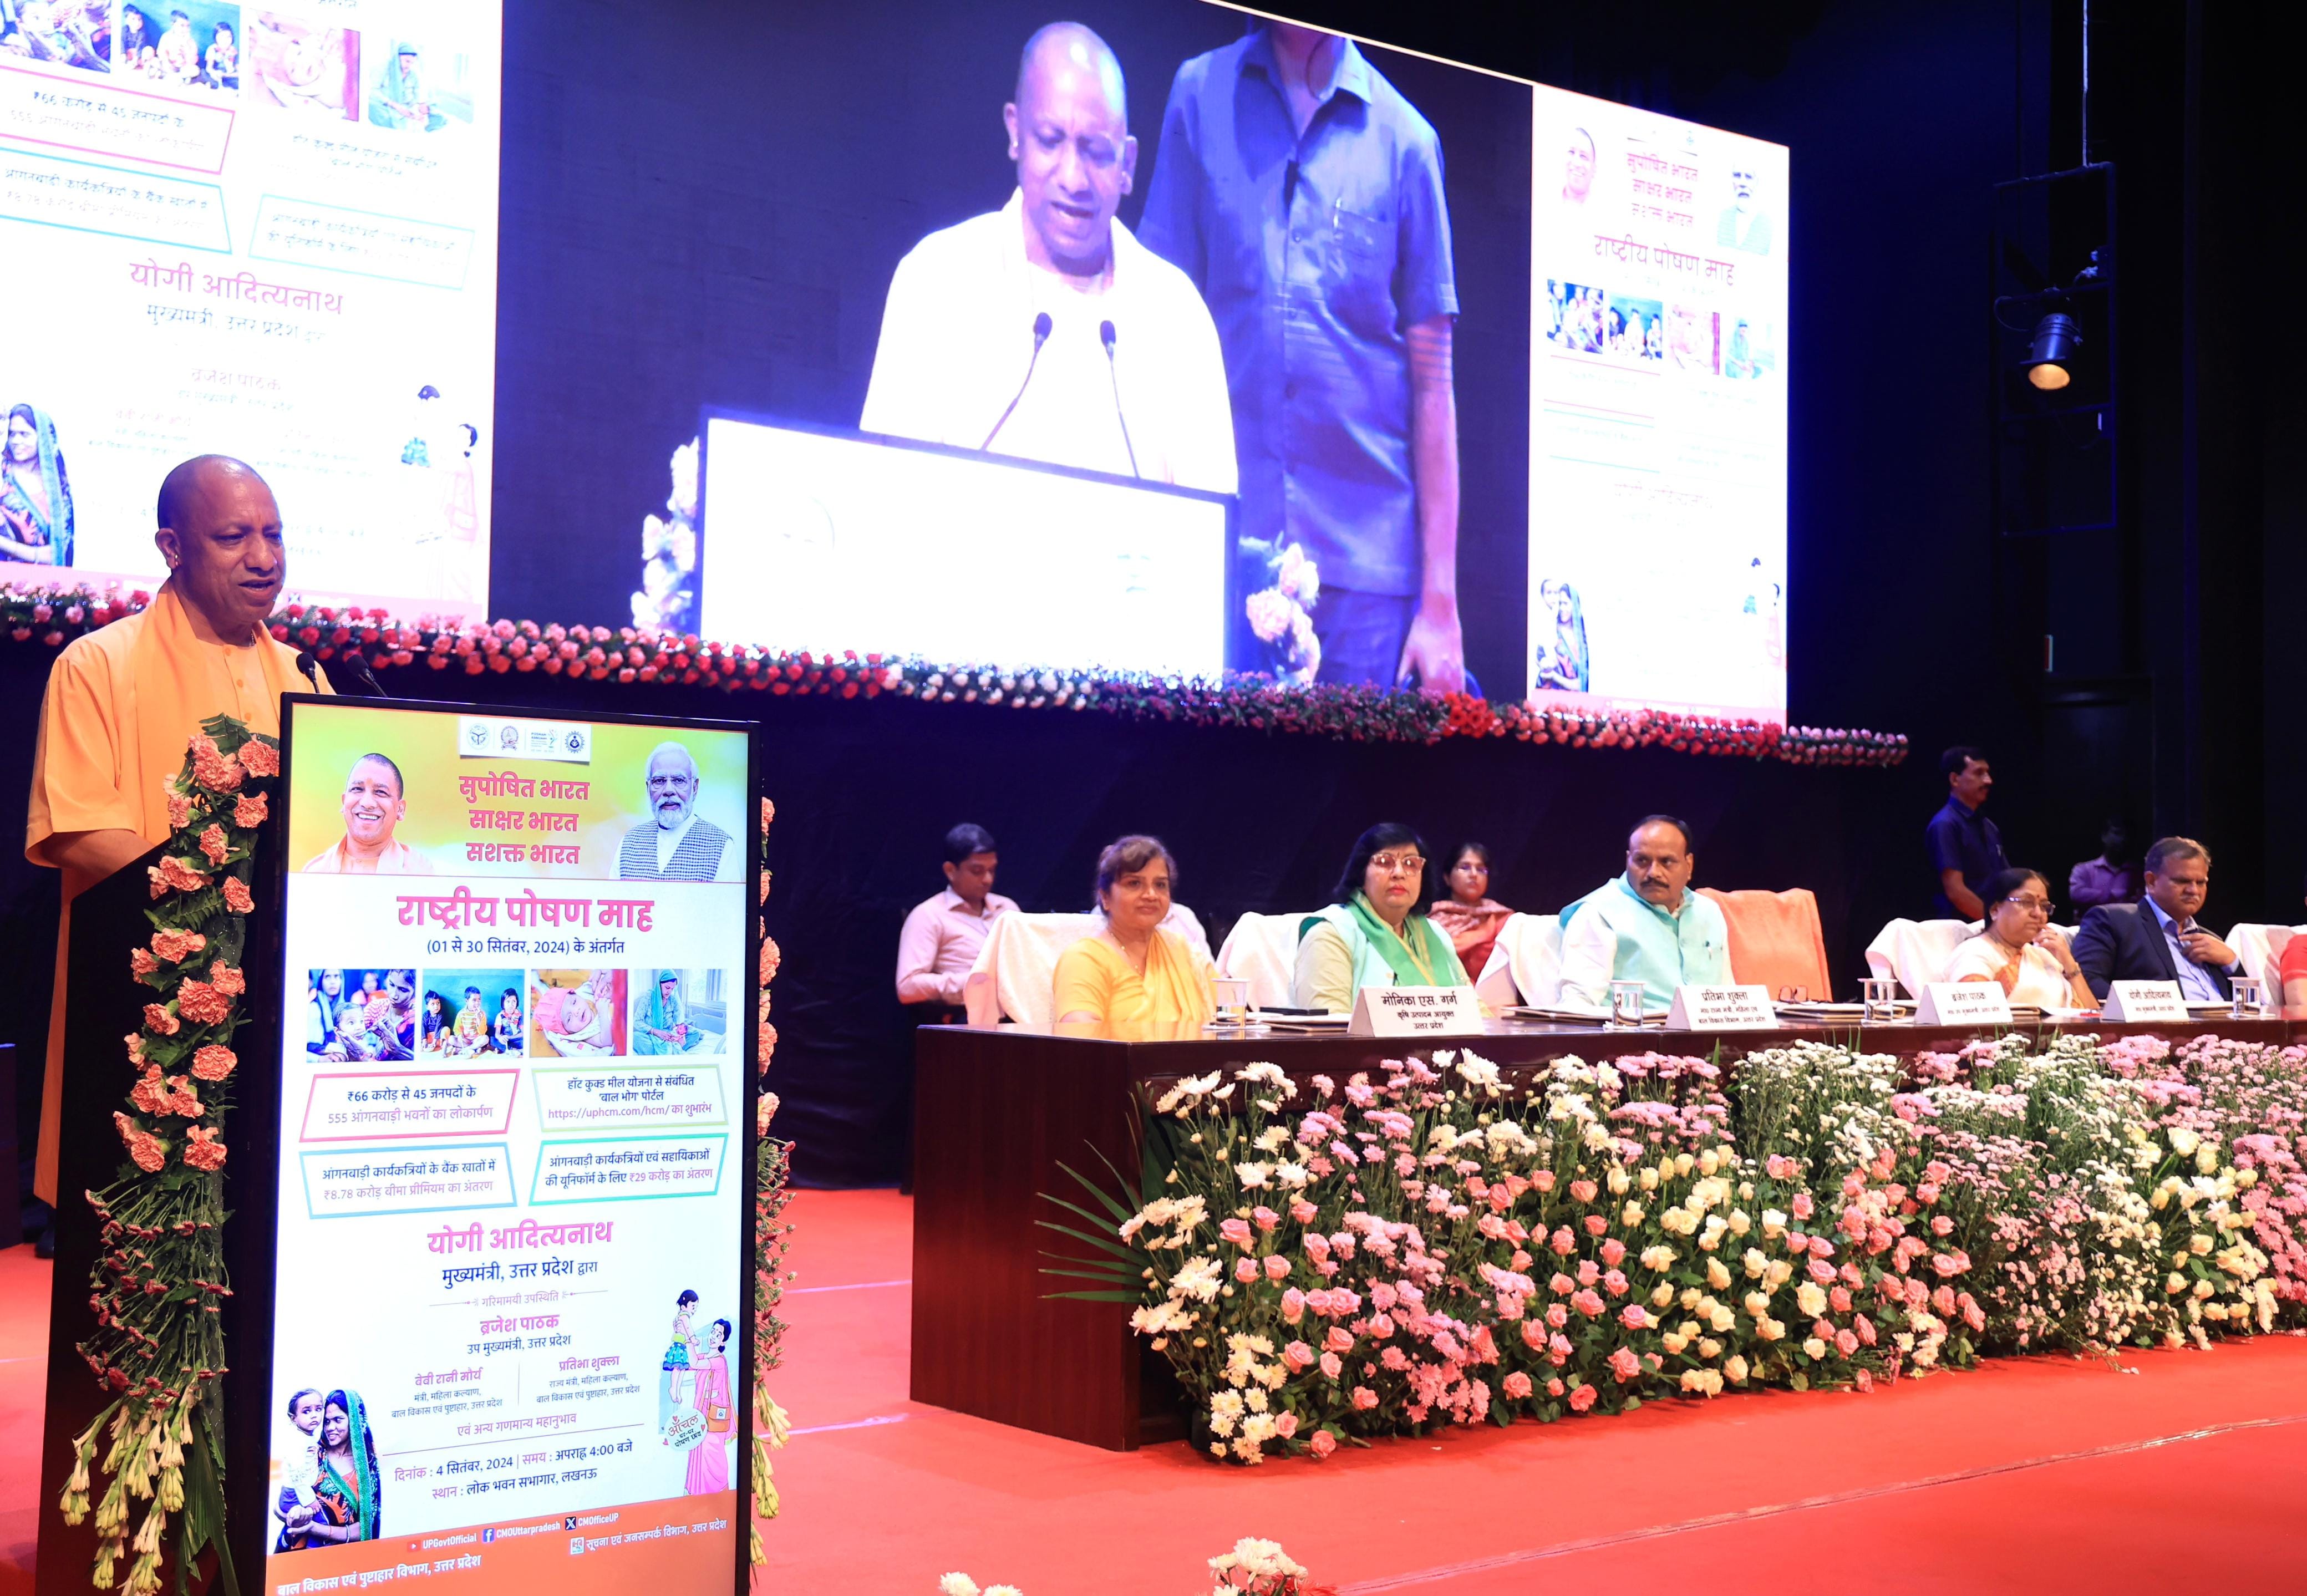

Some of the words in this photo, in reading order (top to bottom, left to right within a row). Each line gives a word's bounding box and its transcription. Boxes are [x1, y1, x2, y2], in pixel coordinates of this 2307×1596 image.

[1594, 233, 1648, 265] राष्ट्रीय
[1654, 243, 1699, 276] पोषण
[1705, 258, 1734, 286] माह
[130, 258, 194, 292] योगी
[203, 271, 343, 314] आदित्यनाथ
[459, 771, 536, 804] सुपोषित
[540, 780, 590, 800] भारत
[469, 810, 525, 831] साक्षर
[529, 812, 579, 832] भारत
[466, 842, 526, 862] सशक्त
[530, 845, 581, 865] भारत
[397, 885, 500, 929] राष्ट्रीय
[505, 888, 592, 928] पोषण
[597, 899, 655, 932] माह
[427, 939, 447, 955] (01
[451, 937, 463, 953] से
[467, 941, 484, 953] 30
[487, 938, 530, 955] सितंबर,
[533, 940, 570, 955] 2024)
[574, 938, 586, 953] के
[588, 937, 625, 954] अंतर्गत
[1381, 992, 1416, 1006] मोनिका
[1417, 995, 1438, 1007] एस.
[1440, 990, 1457, 1005] गर्ग
[1701, 989, 1725, 1002] प्रतिभा
[1727, 992, 1748, 1004] शुक्ला
[1397, 1010, 1409, 1020] कृषि
[1434, 1010, 1454, 1020] आयुक्त
[1430, 1020, 1443, 1029] प्रदेश
[568, 1076, 582, 1090] हॉट
[585, 1078, 605, 1092] कुक्ड
[608, 1076, 625, 1088] मील
[627, 1076, 653, 1087] योजना
[655, 1075, 663, 1087] से
[665, 1074, 694, 1087] संबंधित
[347, 1091, 368, 1102] ₹66
[372, 1087, 398, 1103] करोड़
[402, 1086, 410, 1100] से
[413, 1089, 426, 1099] 45
[430, 1085, 463, 1099] जनपदों
[466, 1085, 477, 1098] के
[642, 1089, 664, 1101] पोर्टल
[328, 1112, 348, 1124] 555
[351, 1108, 400, 1124] आंगनबाड़ी
[404, 1106, 430, 1121] भवनों
[433, 1108, 446, 1120] का
[450, 1105, 493, 1119] लोकार्पण
[548, 1104, 670, 1120] https://uphcm.com/hcm/
[672, 1105, 683, 1114] का
[685, 1101, 712, 1116] शुभारंभ
[550, 1153, 592, 1168] आंगनबाड़ी
[646, 1150, 659, 1162] एवं
[661, 1148, 711, 1161] सहायिकाओं
[322, 1165, 370, 1181] आंगनबाड़ी
[429, 1162, 438, 1174] के
[442, 1160, 459, 1173] बैंक
[461, 1160, 486, 1173] खातों
[545, 1174, 558, 1187] की
[560, 1172, 595, 1190] यूनिफॉर्म
[597, 1172, 606, 1184] के
[609, 1171, 627, 1183] लिए
[629, 1172, 646, 1183] ₹29
[649, 1169, 670, 1183] करोड़
[673, 1170, 684, 1180] का
[687, 1167, 713, 1179] अंतरण
[324, 1189, 353, 1200] ₹8.78
[357, 1185, 381, 1200] करोड़
[385, 1184, 406, 1197] बीमा
[410, 1182, 444, 1195] प्रीमियम
[448, 1182, 461, 1193] का
[464, 1180, 493, 1192] अंतरण
[427, 1222, 484, 1254] योगी
[489, 1218, 613, 1249] आदित्यनाथ
[442, 1261, 505, 1289] मुख्यमंत्री,
[509, 1262, 537, 1279] उत्तर
[542, 1256, 574, 1276] प्रदेश
[578, 1261, 598, 1275] द्वारा
[481, 1293, 522, 1307] गरिमामयी
[524, 1290, 559, 1304] उपस्थिति
[480, 1315, 517, 1335] ब्रजेश
[520, 1314, 560, 1331] पाठक
[467, 1343, 480, 1355] उप
[484, 1337, 525, 1356] मुख्यमंत्री,
[527, 1337, 547, 1349] उत्तर
[550, 1333, 572, 1346] प्रदेश
[559, 1357, 590, 1371] प्रतिभा
[591, 1356, 620, 1371] शुक्ला
[415, 1372, 434, 1386] बेबी
[436, 1369, 458, 1384] रानी
[460, 1367, 484, 1381] मौर्य
[581, 1375, 601, 1385] महिला
[431, 1390, 452, 1400] महिला
[408, 1407, 431, 1416] विकास
[433, 1404, 443, 1414] एवं
[471, 1401, 485, 1410] उत्तर
[486, 1397, 503, 1407] प्रदेश
[458, 1423, 471, 1436] एवं
[474, 1423, 494, 1435] अन्य
[496, 1418, 533, 1432] गणमान्य
[536, 1414, 577, 1429] महानुभाव
[394, 1466, 428, 1482] दिनांक
[436, 1466, 443, 1476] 4
[447, 1459, 483, 1475] सितंबर,
[486, 1456, 513, 1470] 2024
[522, 1452, 547, 1465] समय
[555, 1447, 587, 1461] अपराह्न
[590, 1444, 614, 1456] 4:00
[617, 1439, 633, 1453] बजे
[432, 1486, 458, 1500] स्थान
[466, 1480, 490, 1495] लोक
[492, 1478, 515, 1491] भवन
[519, 1473, 558, 1488] सभागार,
[562, 1468, 597, 1483] लखनऊ
[423, 1533, 477, 1549] UPGovtOfficial
[496, 1521, 561, 1539] CMOUttarpradesh
[578, 1513, 619, 1528] CMOfficeUP
[586, 1537, 609, 1551] सूचना
[611, 1532, 622, 1546] एवं
[624, 1526, 662, 1543] जनसम्पर्क
[663, 1524, 689, 1537] विभाग,
[692, 1523, 707, 1533] उत्तर
[709, 1518, 727, 1531] प्रदेश
[277, 1583, 300, 1596] बाल
[303, 1576, 339, 1593] विकास
[341, 1571, 357, 1587] एवं
[359, 1568, 394, 1588] पुष्टाहार
[397, 1563, 431, 1578] विभाग,
[434, 1559, 455, 1572] उत्तर
[457, 1553, 482, 1568] प्रदेश
